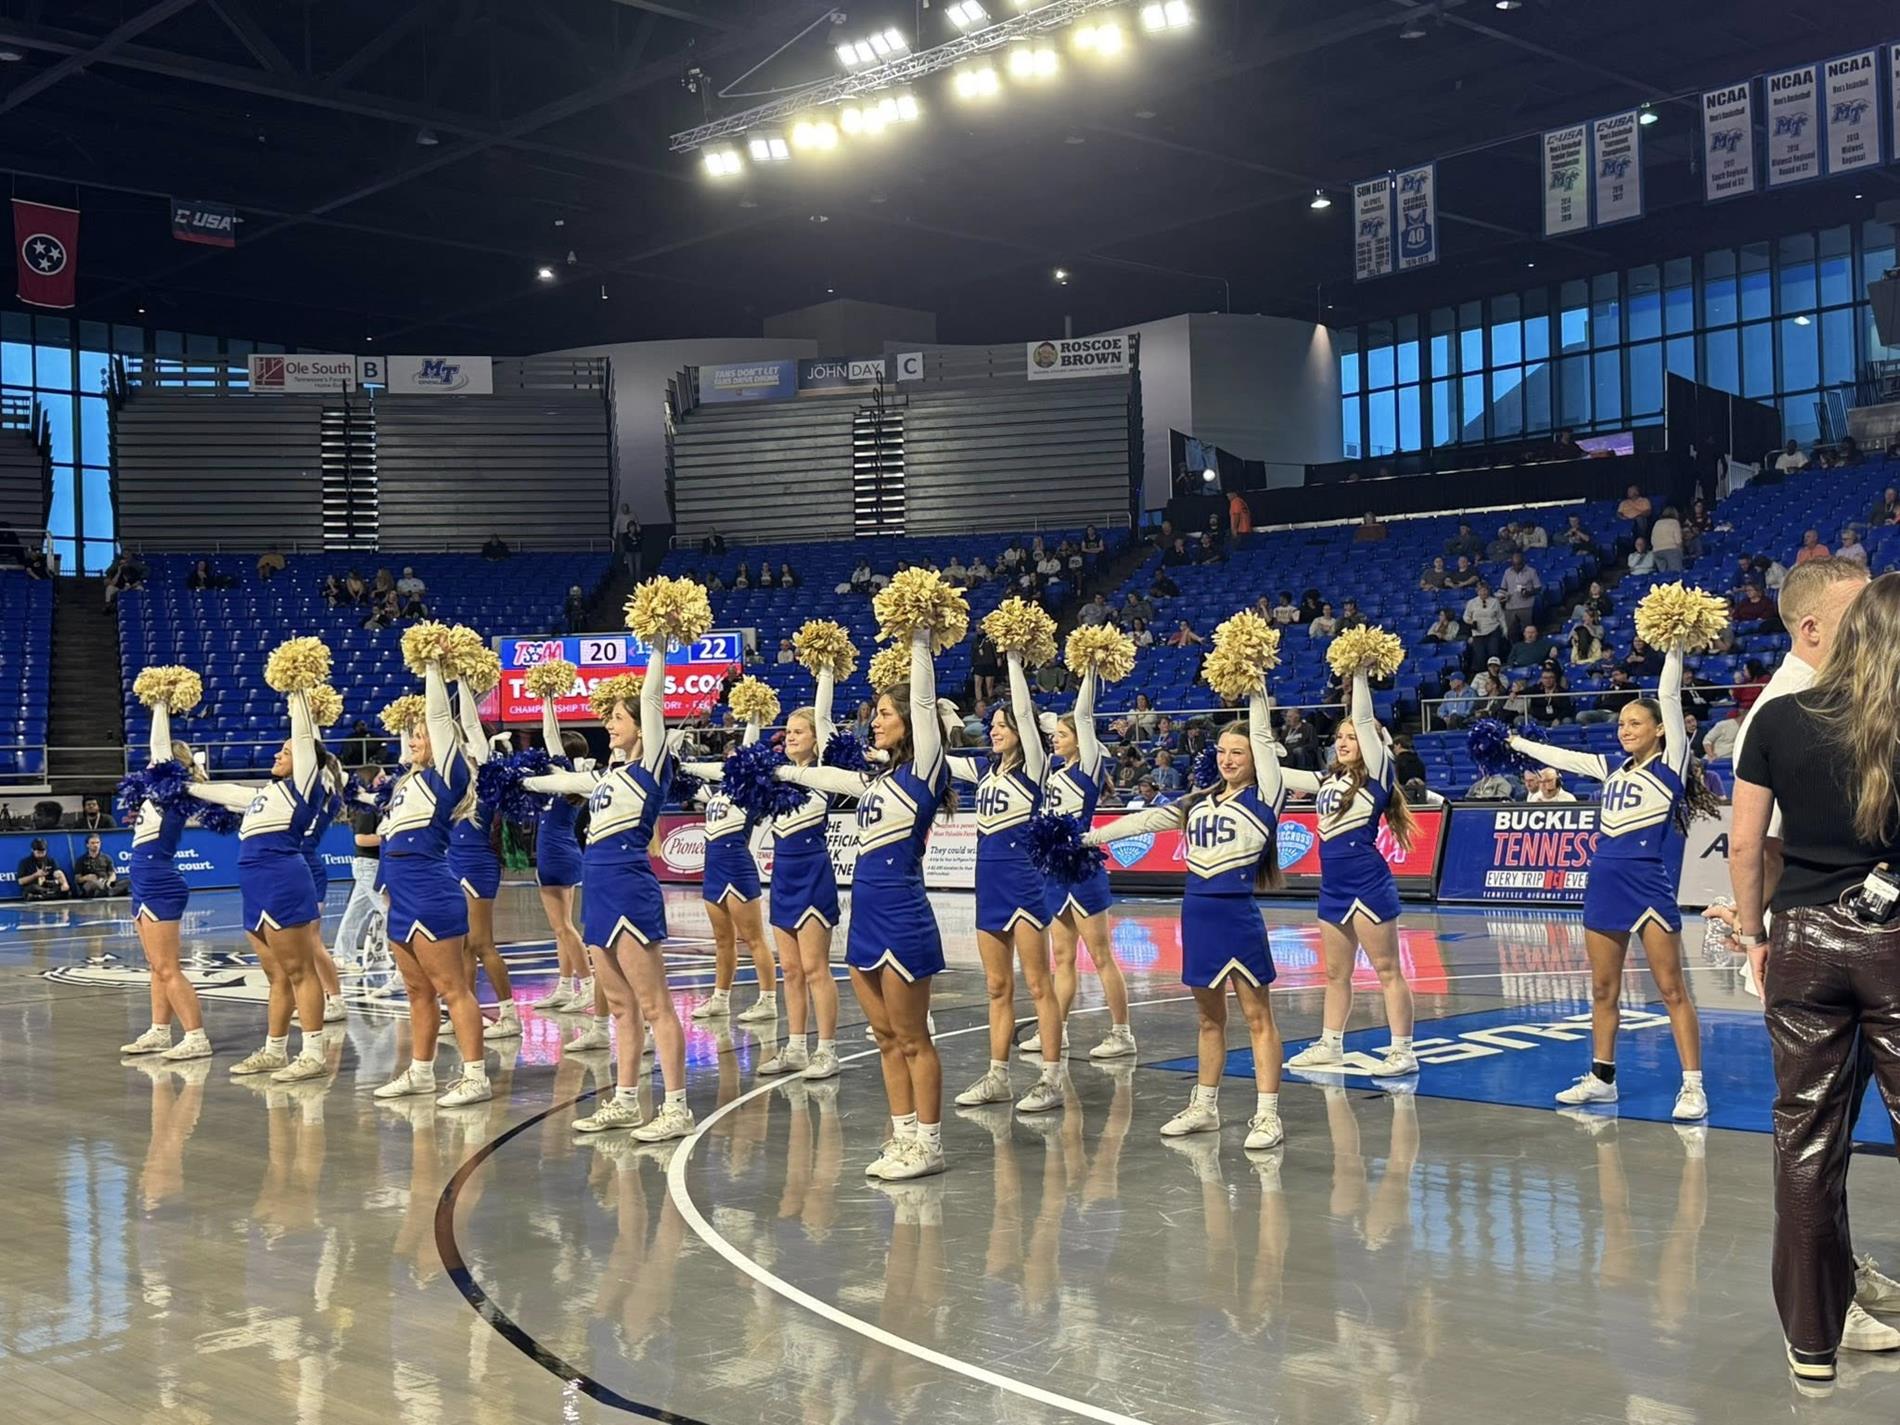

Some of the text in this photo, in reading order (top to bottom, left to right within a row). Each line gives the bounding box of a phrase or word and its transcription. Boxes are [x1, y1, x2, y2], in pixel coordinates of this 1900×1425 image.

[1828, 56, 1872, 77] NCAA
[1771, 70, 1813, 92] NCAA
[1706, 87, 1748, 109] NCAA
[1357, 180, 1387, 198] SUN BELT
[1408, 226, 1425, 244] 40
[1061, 339, 1122, 353] ROSCOE
[286, 361, 351, 375] Ole South
[903, 357, 917, 374] C
[1061, 352, 1122, 367] BROWN
[364, 362, 378, 378] B
[808, 362, 881, 380] JOHN DAY
[589, 642, 618, 662] 20
[699, 638, 727, 658] 22
[1494, 811, 1594, 830] BUCKLE
[1188, 814, 1236, 848] HHS
[825, 835, 860, 847] FFICIA
[931, 846, 947, 856] They
[178, 861, 214, 871] court.
[1487, 872, 1518, 886] EVERY
[1521, 872, 1543, 886] TRIP
[1482, 891, 1523, 899] TENNESSEE
